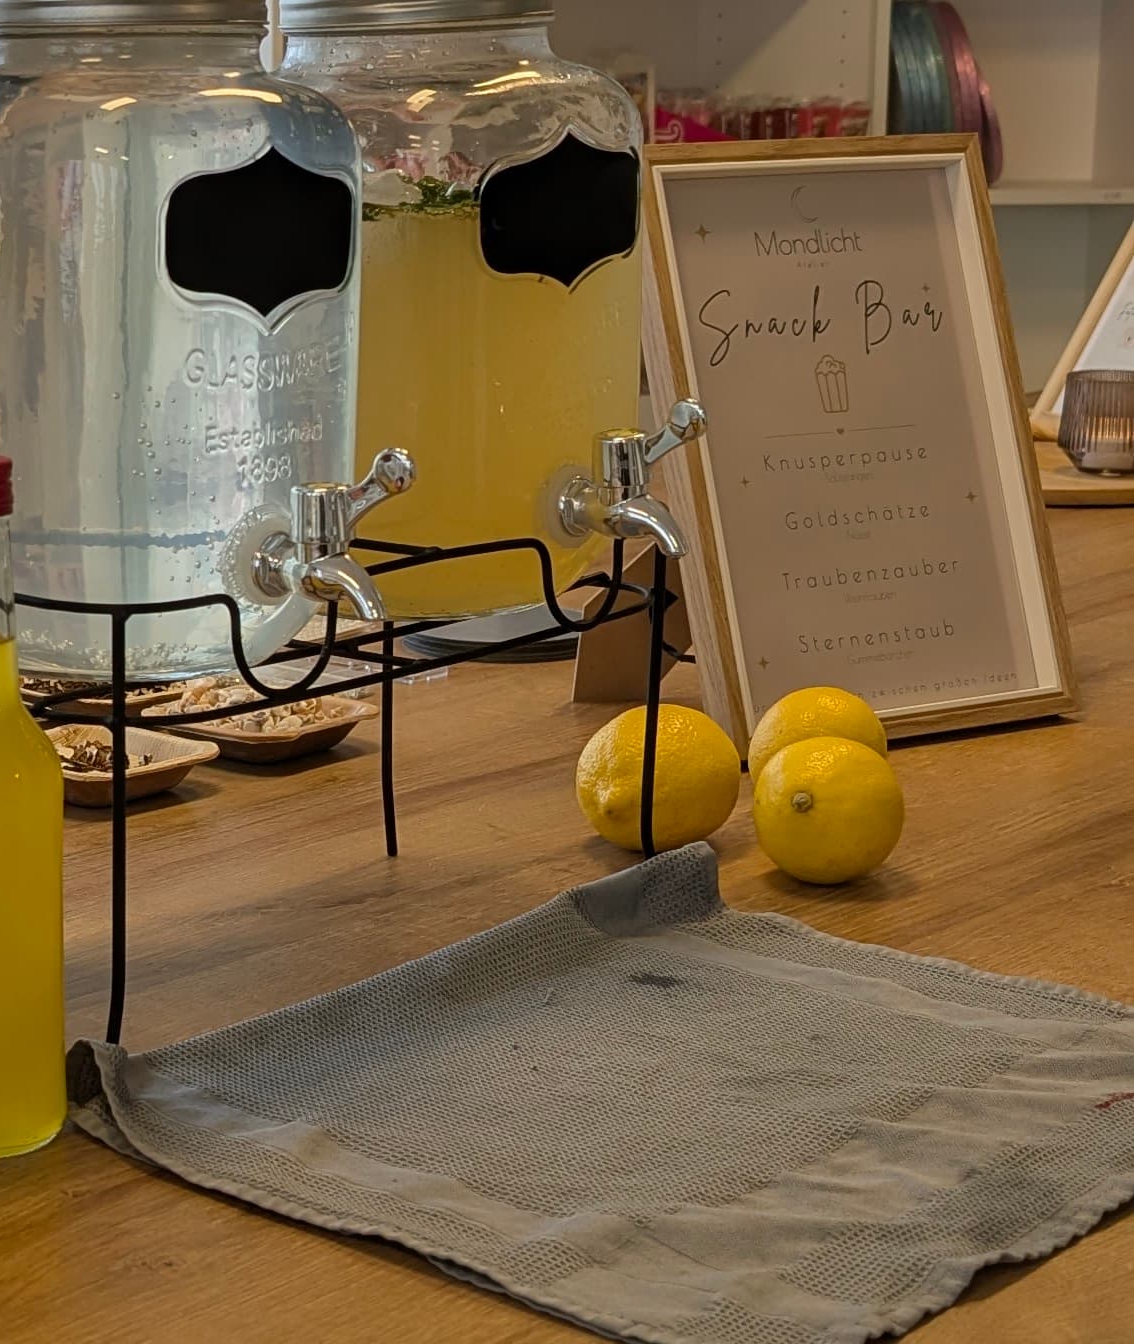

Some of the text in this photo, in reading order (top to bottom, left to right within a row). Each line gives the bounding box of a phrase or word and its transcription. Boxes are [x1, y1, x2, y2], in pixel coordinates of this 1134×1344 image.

[753, 229, 863, 258] Mondlicht
[698, 279, 943, 366] Snack Bar
[203, 416, 324, 453] Established
[235, 455, 293, 485] 1898
[762, 445, 928, 472] Knusperpause
[784, 503, 930, 530] Goldschätze
[780, 558, 961, 592] Traubenzauber
[797, 620, 955, 654] Sternenstaub
